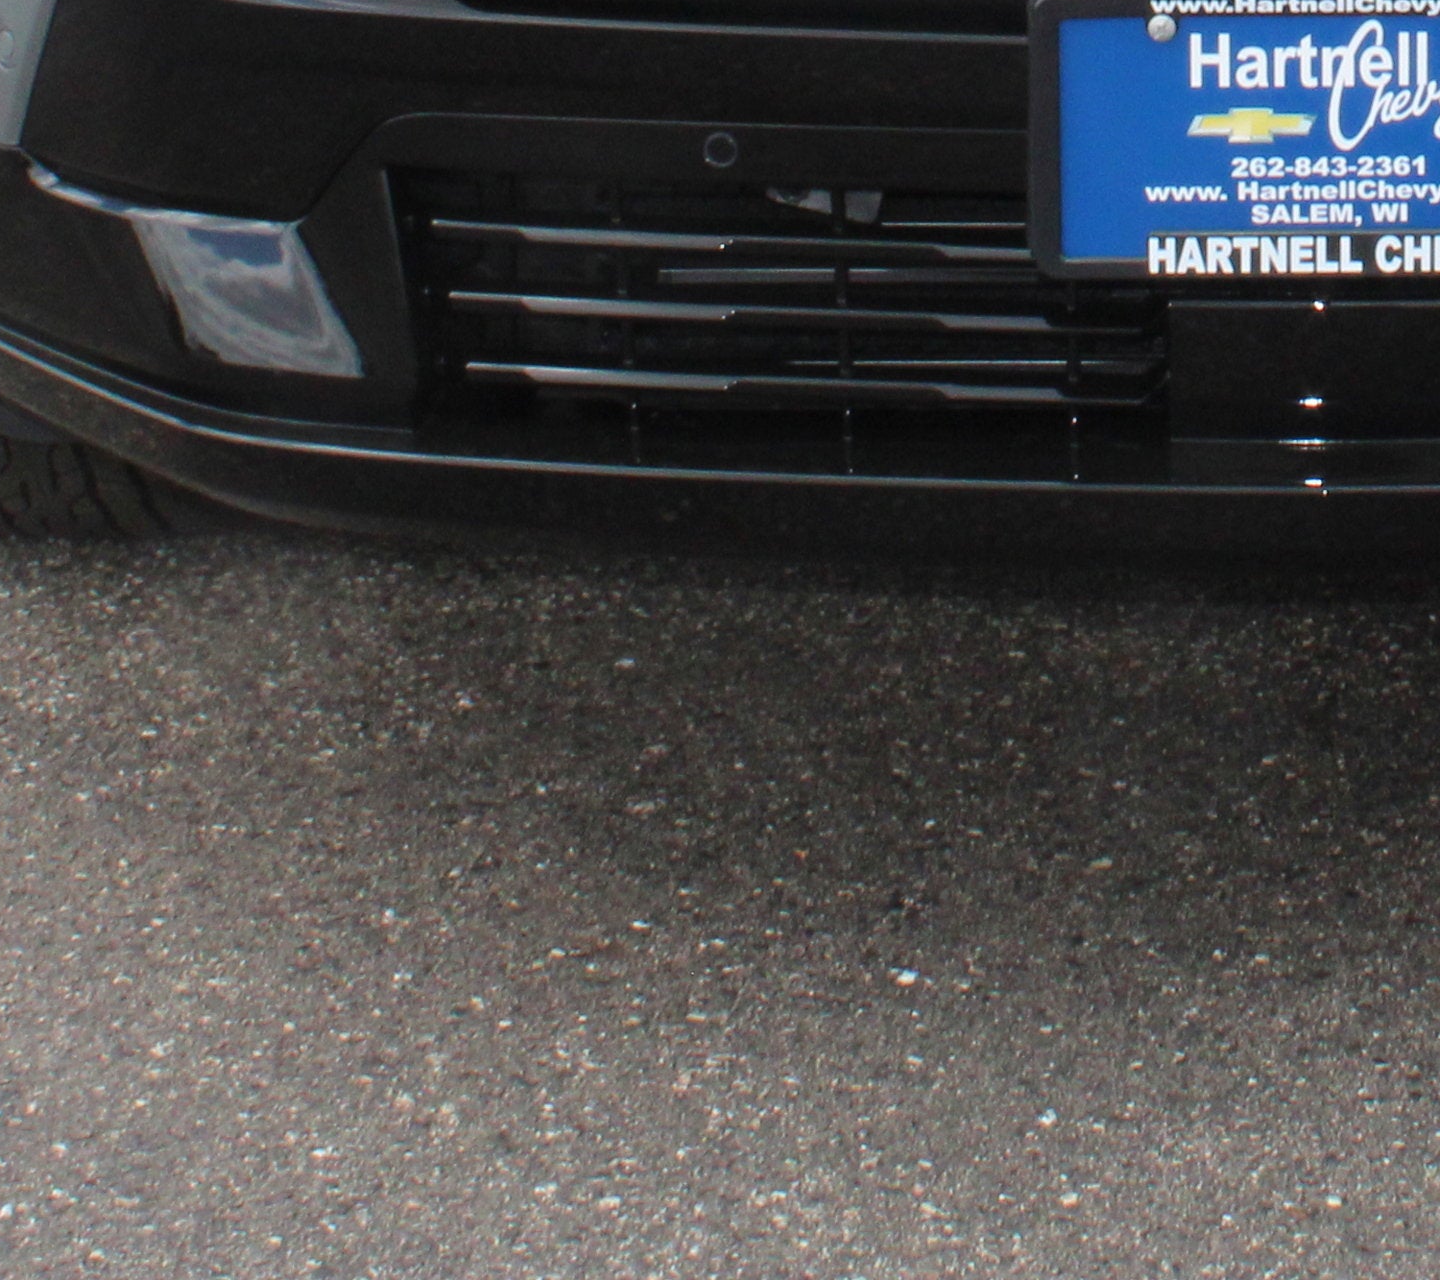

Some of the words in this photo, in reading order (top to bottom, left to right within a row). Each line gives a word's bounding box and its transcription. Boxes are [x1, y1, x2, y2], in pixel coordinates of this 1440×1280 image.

[1190, 31, 1429, 88] Hartnell
[1231, 155, 1427, 177] 262-843-2361
[1145, 186, 1228, 202] www.
[1251, 203, 1363, 227] SALEM,
[1371, 203, 1409, 223] WI
[1148, 236, 1364, 275] HARTNELL
